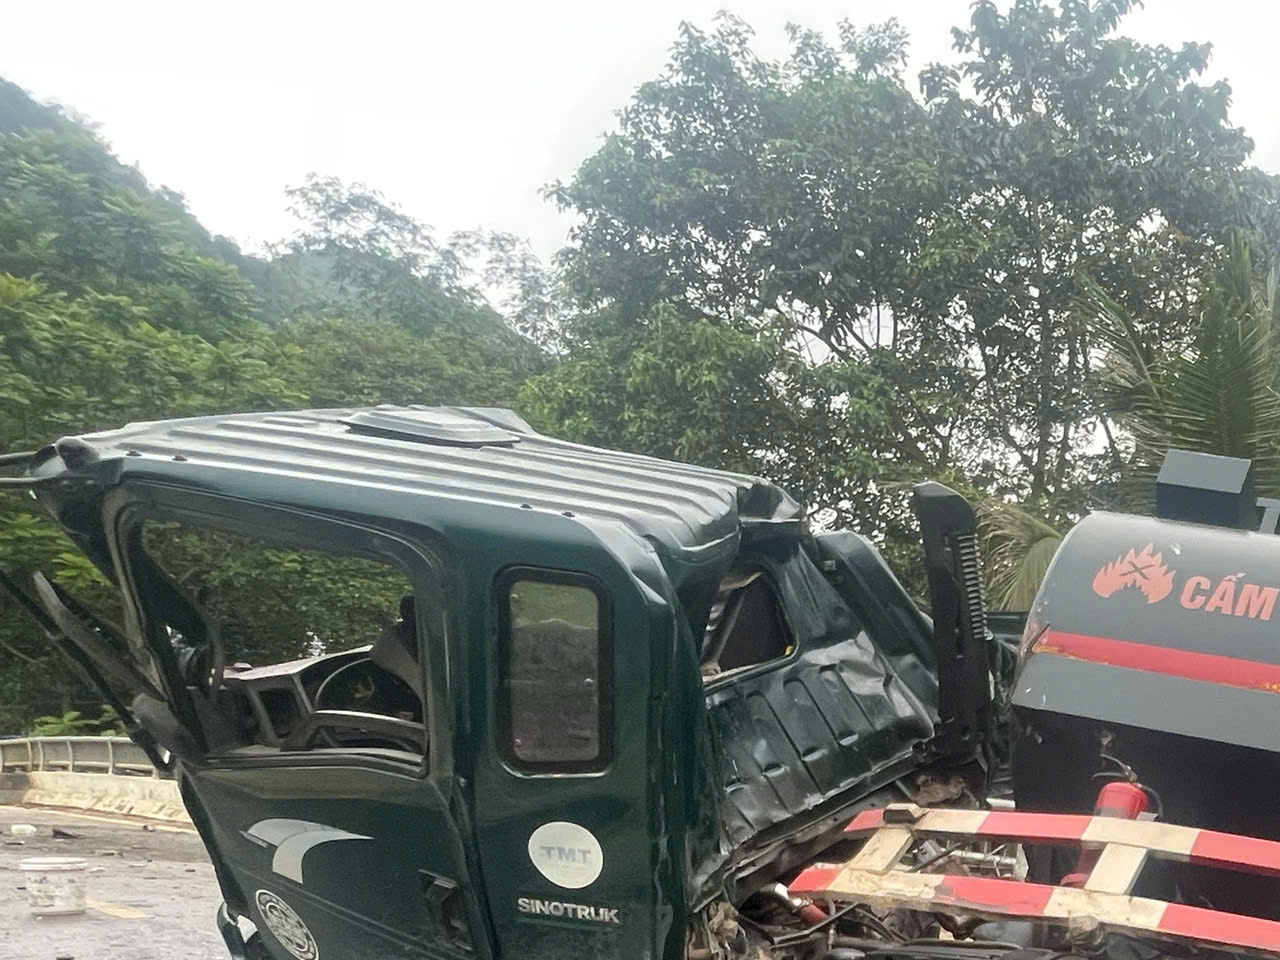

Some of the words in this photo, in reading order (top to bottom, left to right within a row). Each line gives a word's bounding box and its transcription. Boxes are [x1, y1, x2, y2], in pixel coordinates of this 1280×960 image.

[1180, 572, 1280, 621] CẤM
[541, 846, 591, 864] TMT
[517, 897, 620, 924] SINOTRUK
